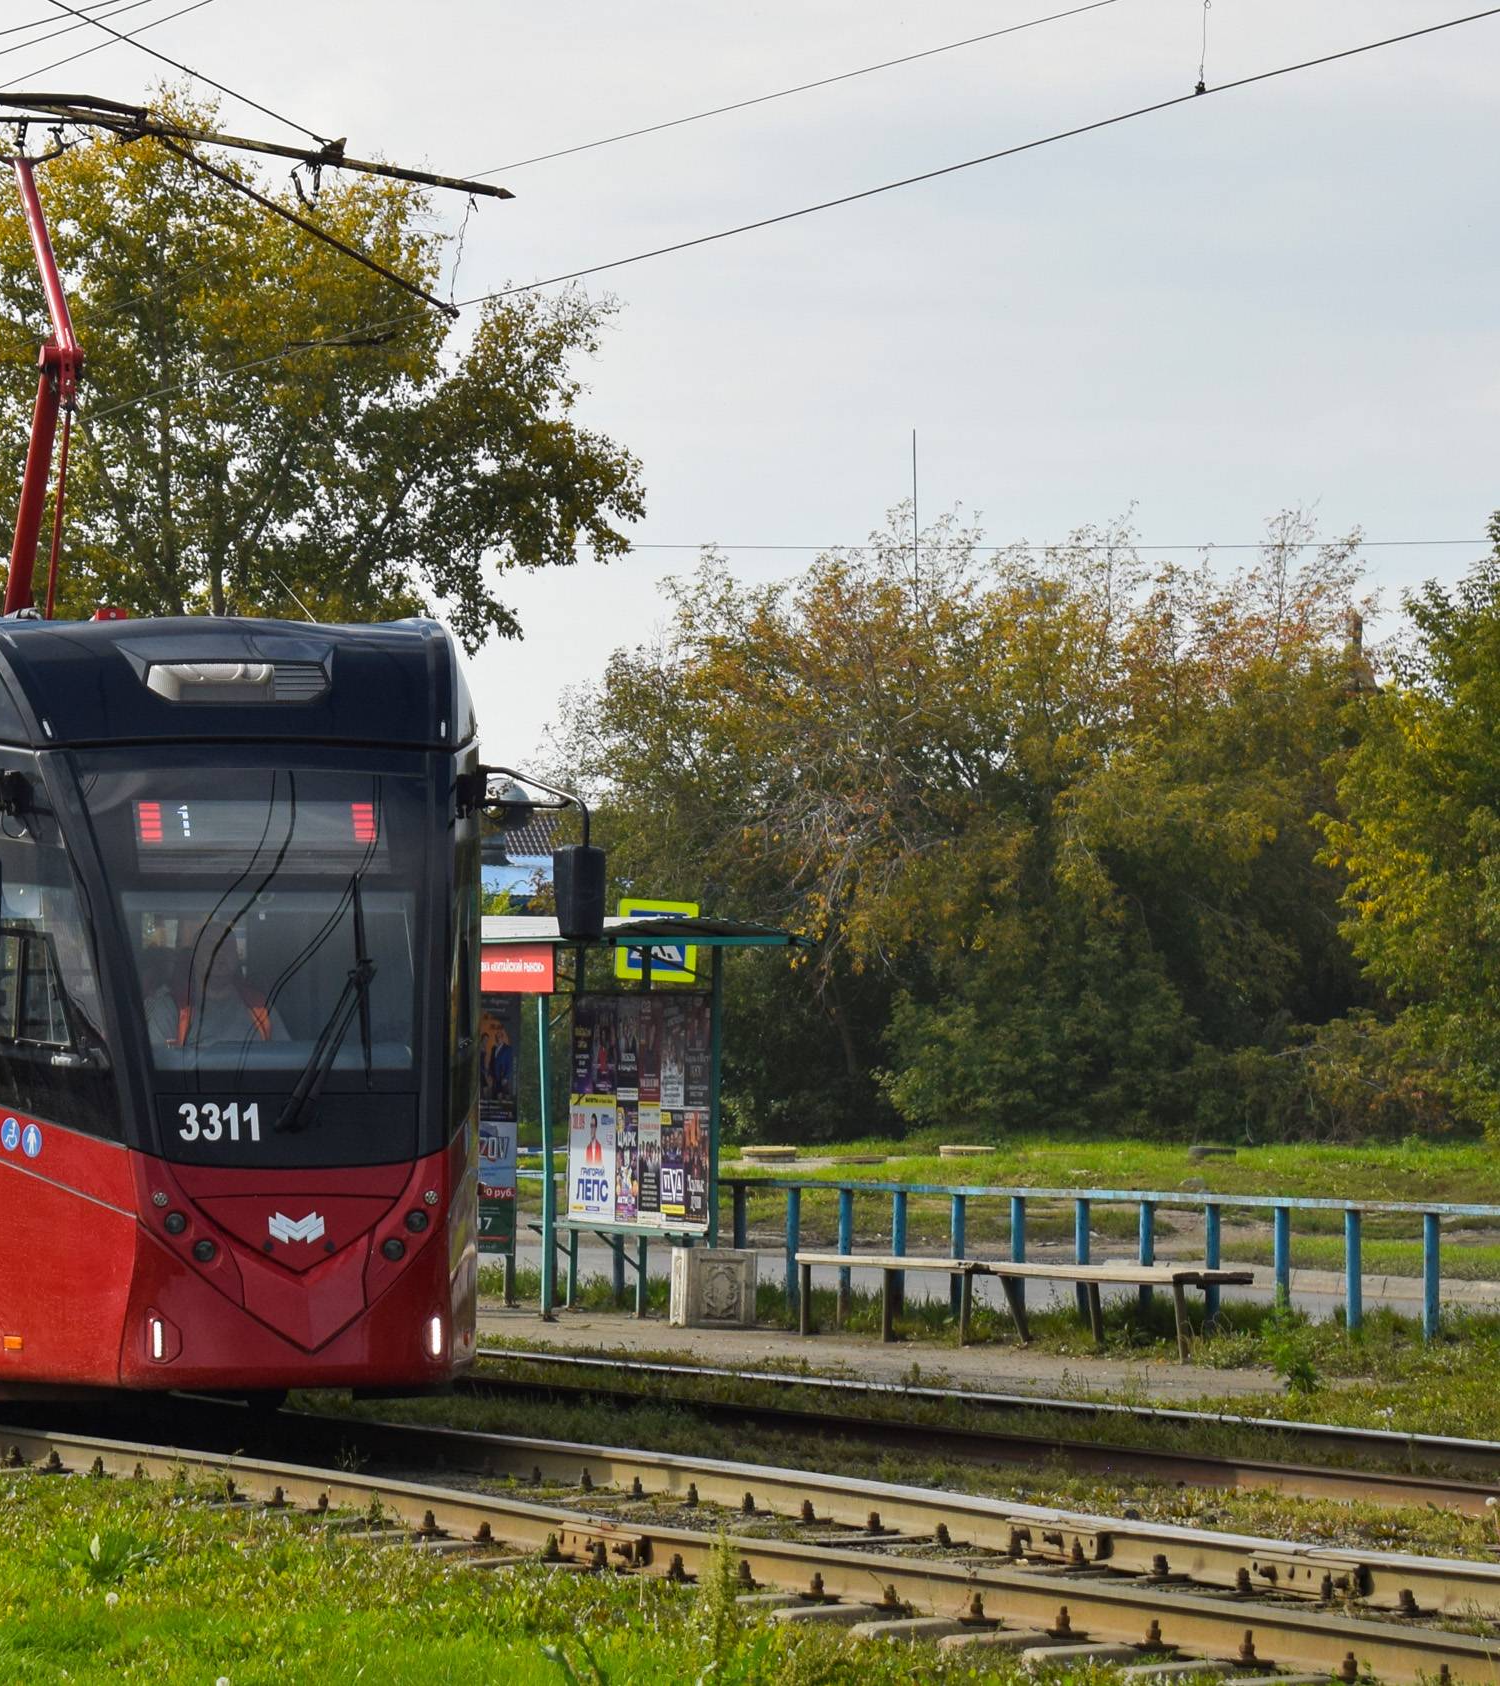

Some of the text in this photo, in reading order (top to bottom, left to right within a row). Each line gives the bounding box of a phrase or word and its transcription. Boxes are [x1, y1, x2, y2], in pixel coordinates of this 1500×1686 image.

[177, 804, 191, 837] 1
[178, 1102, 260, 1141] 3311
[617, 1131, 636, 1147] ЦИРК
[580, 1166, 605, 1177] ГРИГОРИЙ
[576, 1179, 608, 1202] ЛЕПС
